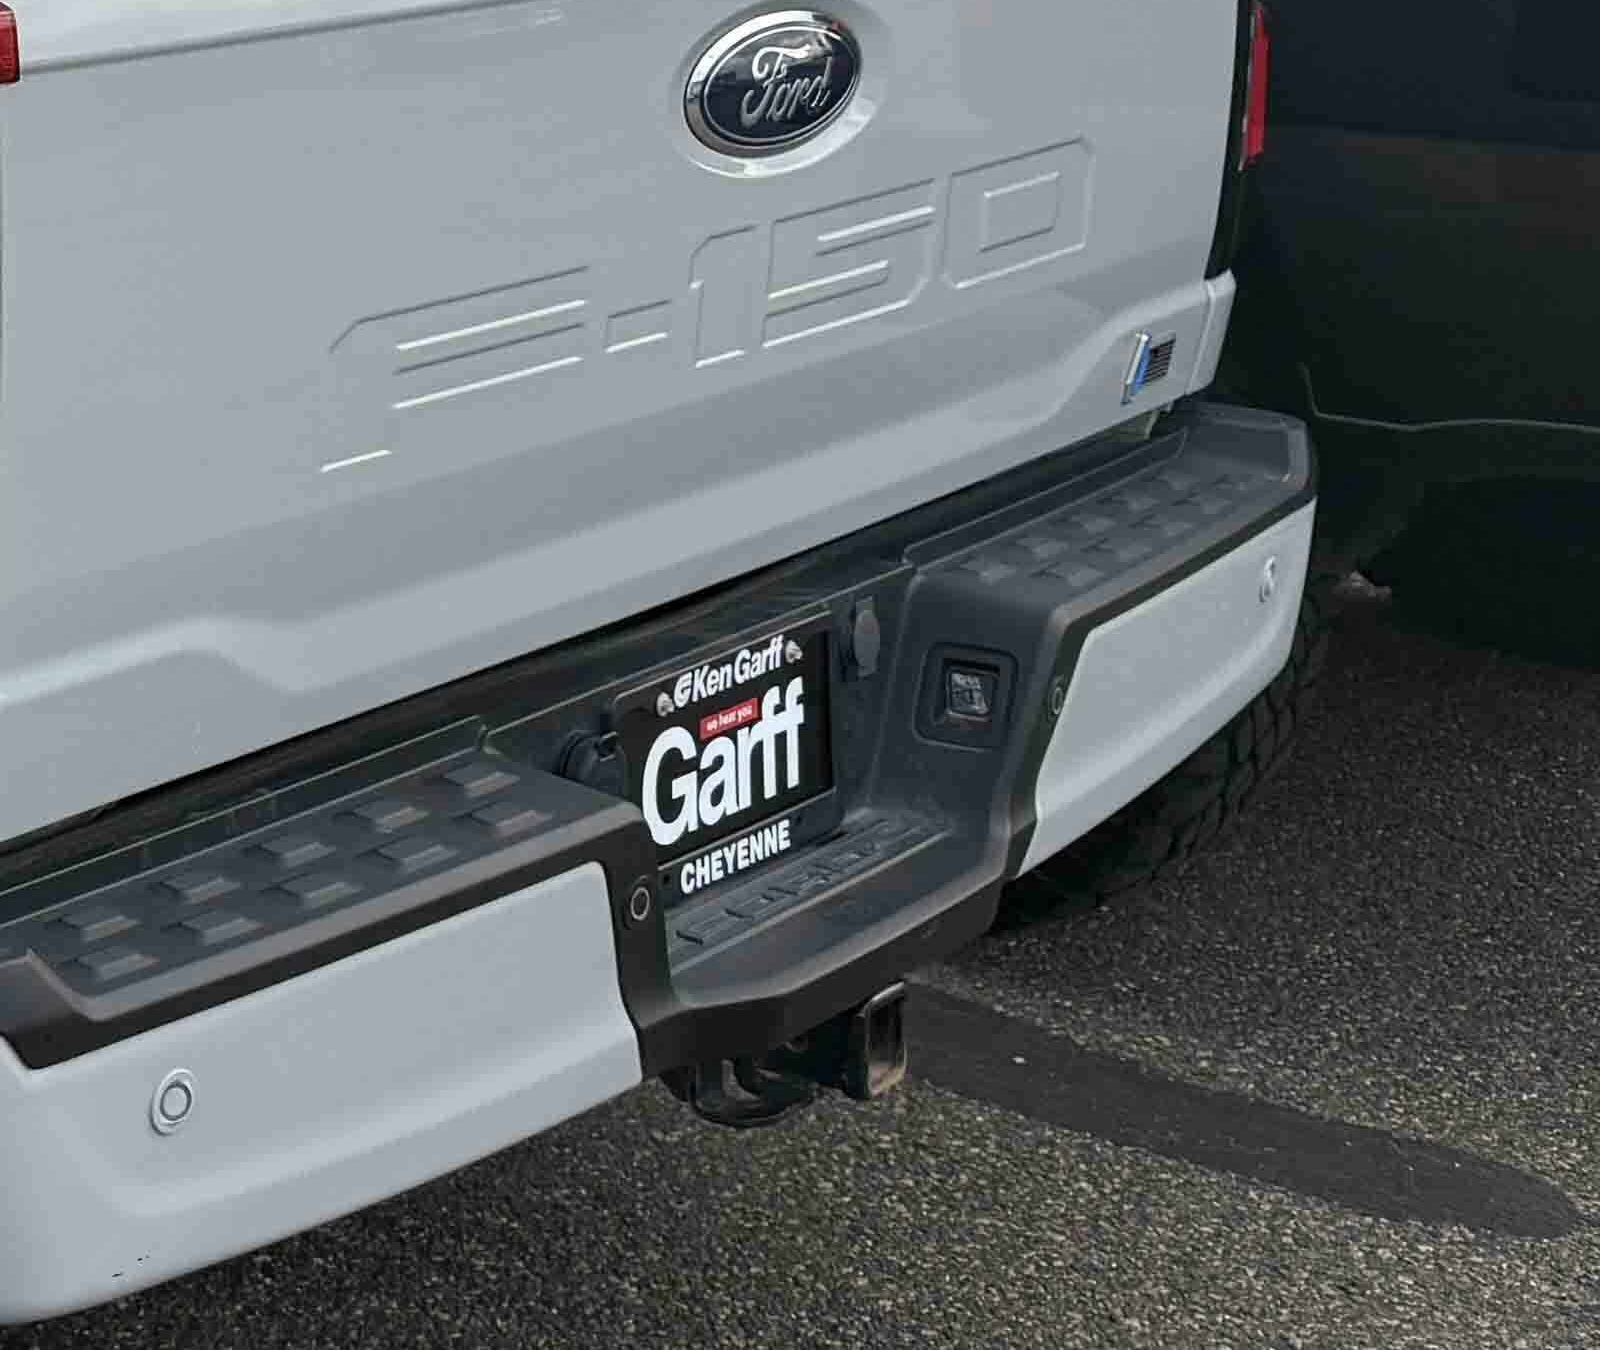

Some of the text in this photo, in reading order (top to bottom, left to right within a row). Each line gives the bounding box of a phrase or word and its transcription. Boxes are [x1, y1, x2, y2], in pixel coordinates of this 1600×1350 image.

[740, 44, 834, 129] Ford
[318, 135, 1097, 474] F-150
[692, 664, 732, 703] Ken
[734, 634, 784, 684] Garff
[642, 676, 805, 846] Garff
[680, 819, 791, 894] CHEYENNE
